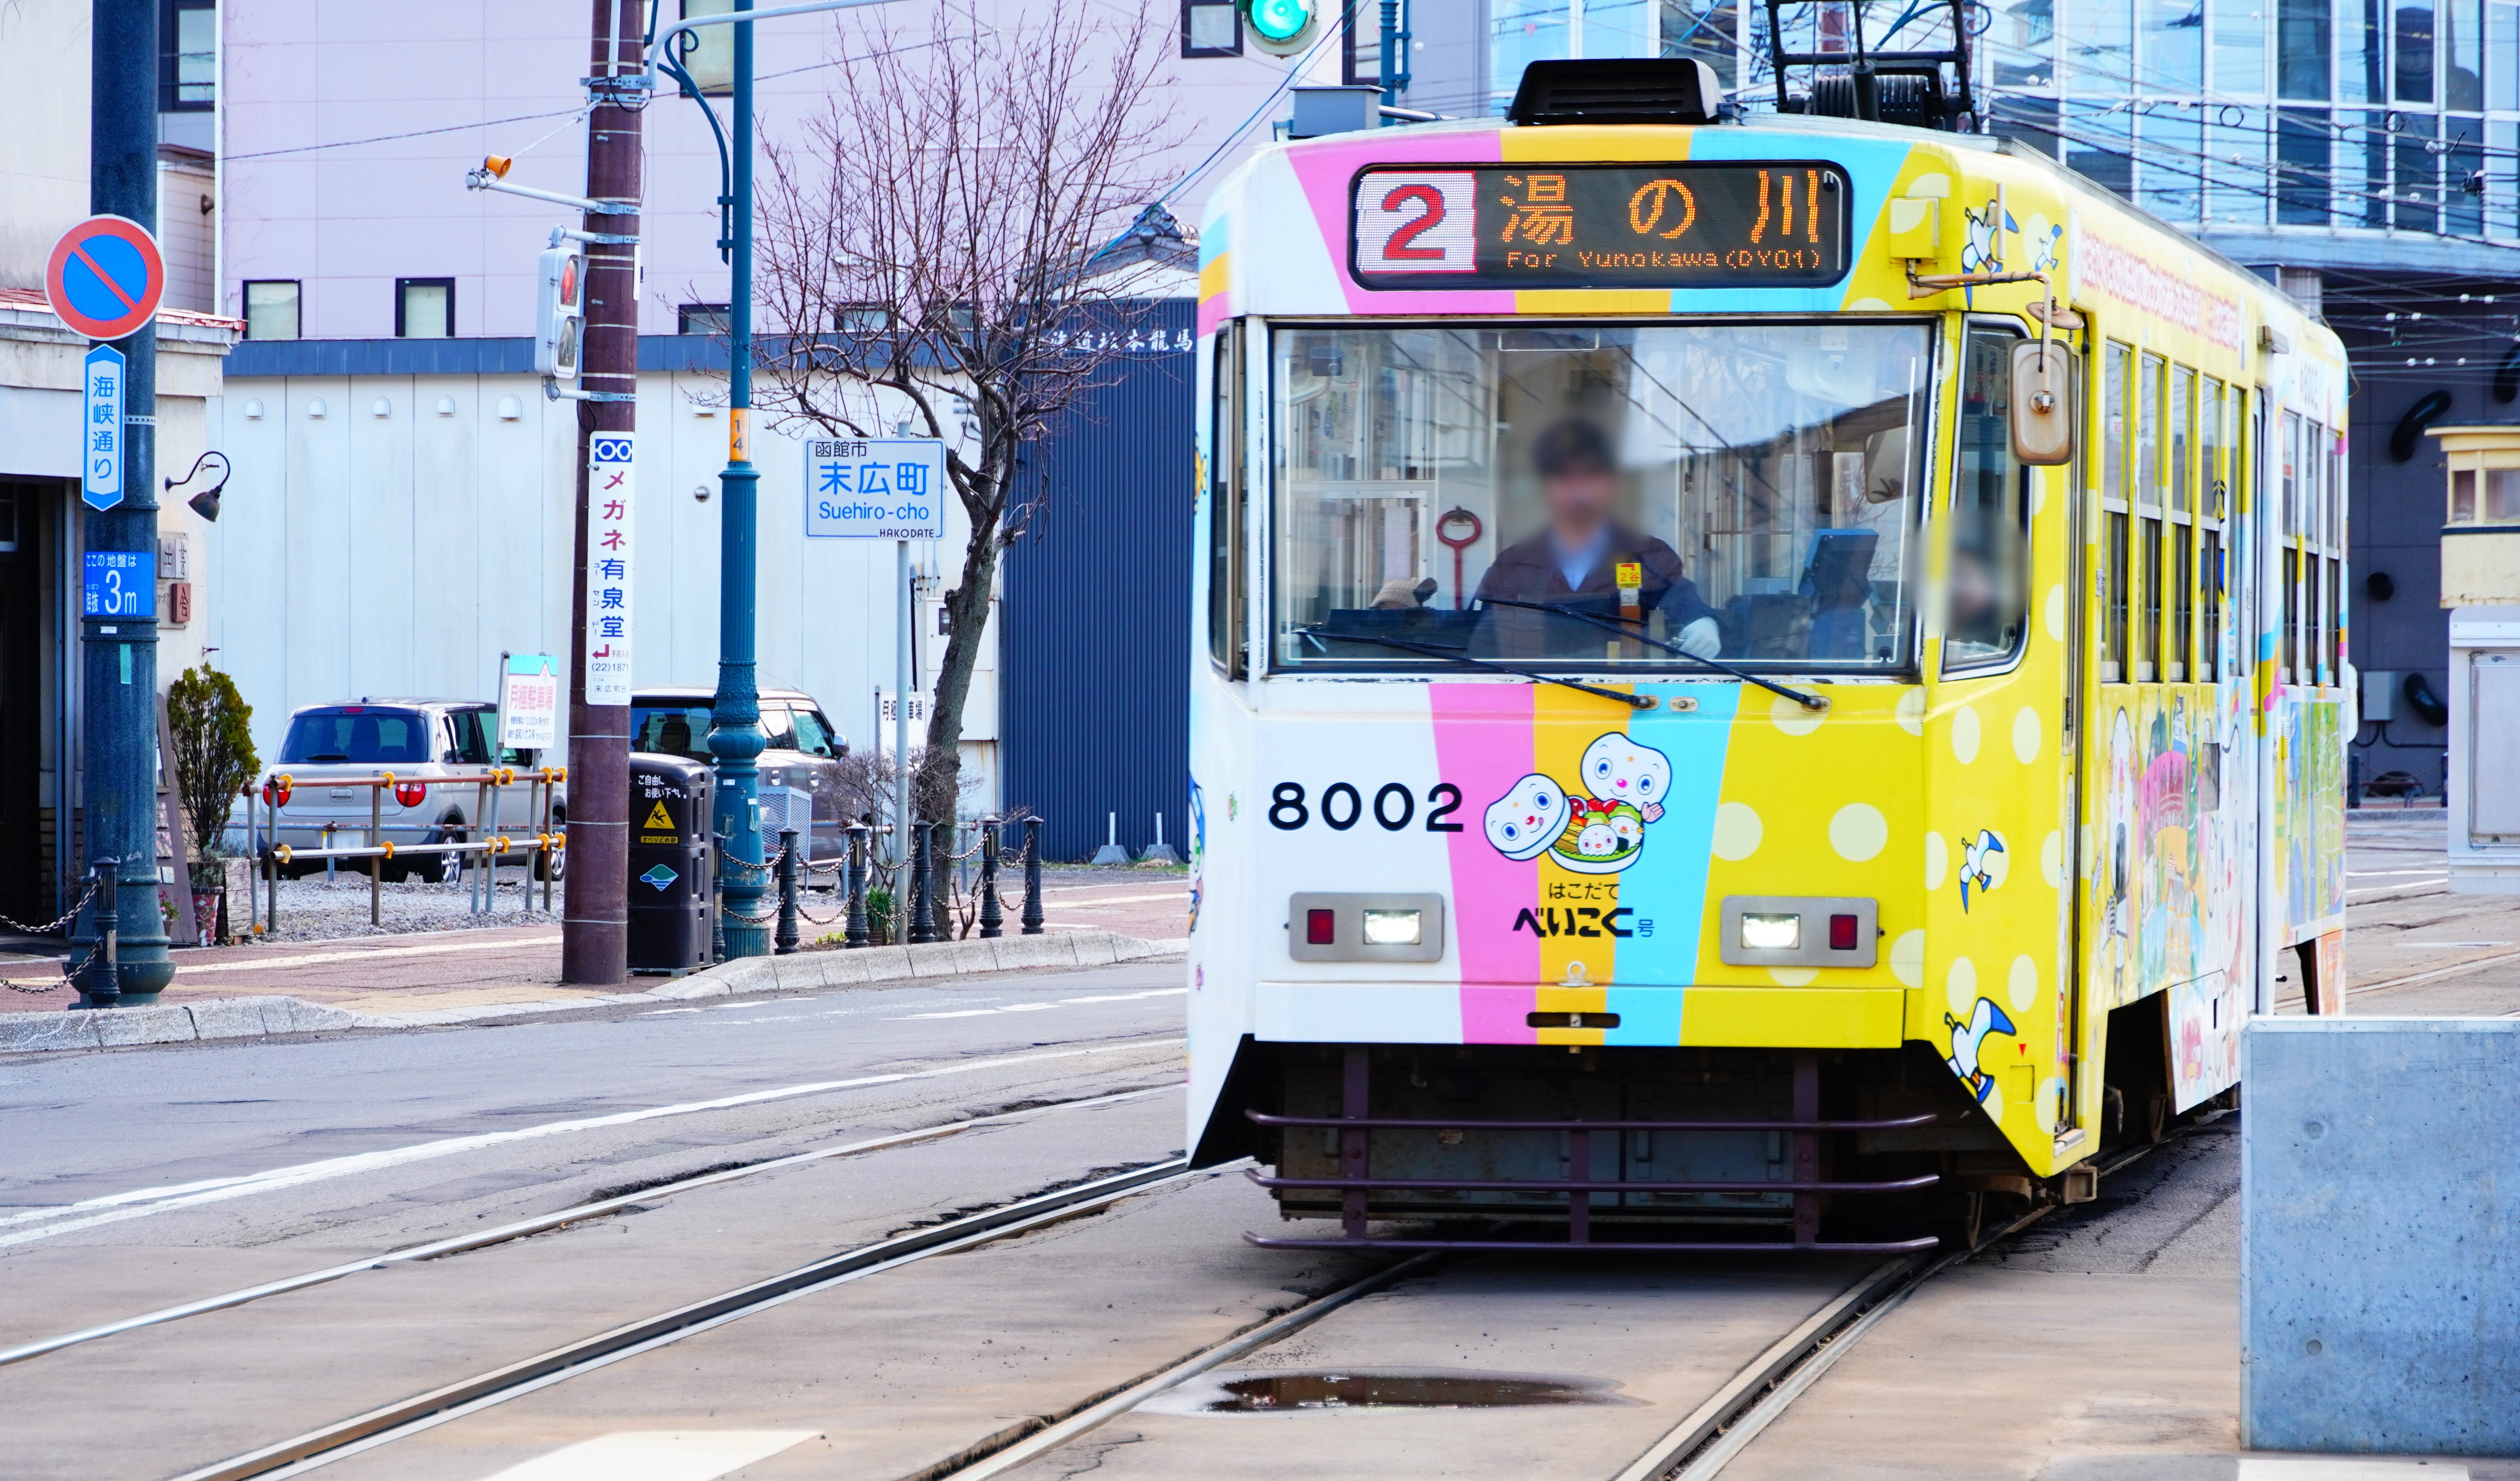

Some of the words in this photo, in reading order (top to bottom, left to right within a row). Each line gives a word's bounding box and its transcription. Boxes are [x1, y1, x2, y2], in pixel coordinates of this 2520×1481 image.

[1499, 170, 1820, 244] 湯の川
[1382, 184, 1446, 259] 2
[1507, 251, 1557, 268] For
[93, 376, 115, 479] 海峡通り
[816, 440, 867, 458] 函館市
[819, 462, 929, 495] 末広町
[819, 502, 929, 520] Suehiro-cho
[880, 529, 934, 538] HAKODATE
[86, 554, 136, 567] ここの地盤は
[592, 663, 629, 671] (22)1871
[509, 685, 553, 711] 月極駐車場
[883, 700, 922, 721] 月極車場
[638, 775, 665, 785] ご自由に
[1269, 782, 1463, 831] 8002
[1549, 882, 1620, 899] はこだて
